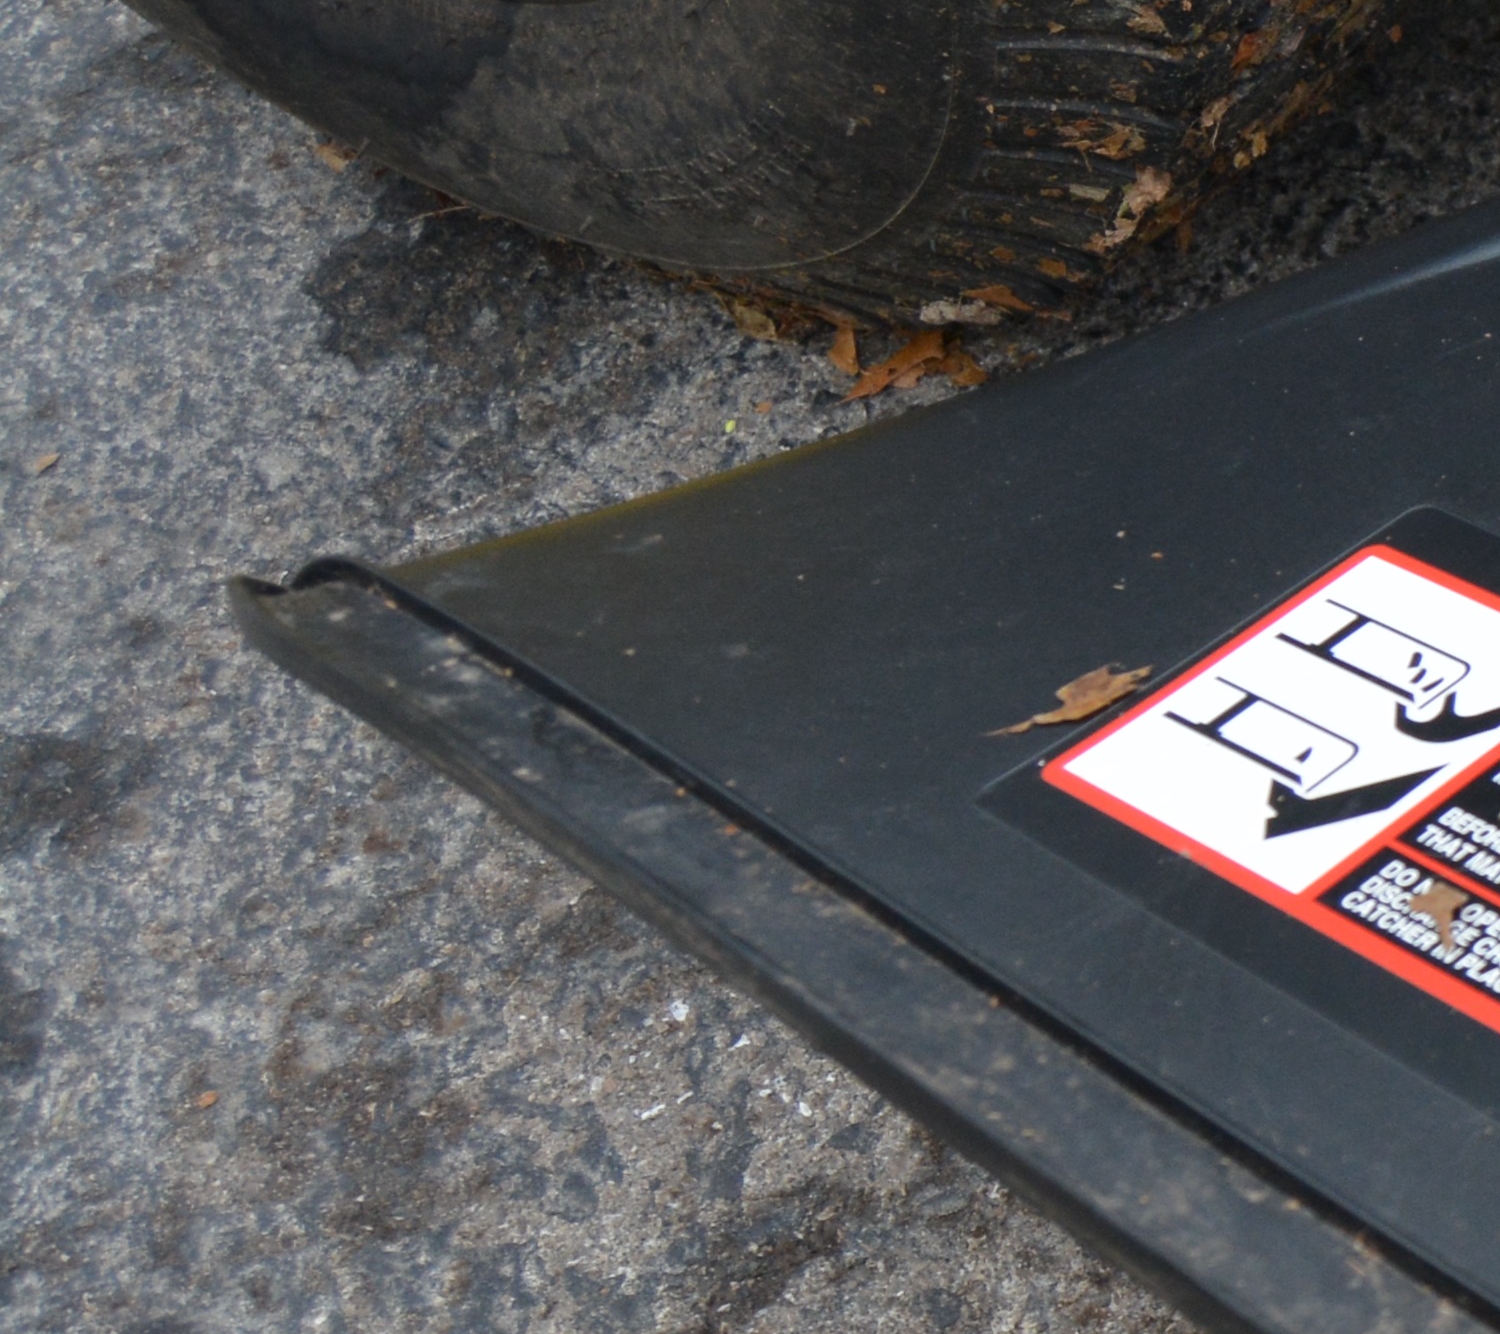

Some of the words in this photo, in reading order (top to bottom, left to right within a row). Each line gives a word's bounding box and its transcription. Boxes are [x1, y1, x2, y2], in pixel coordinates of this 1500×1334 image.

[1416, 823, 1476, 861] THAT
[1378, 859, 1419, 887] DO
[1340, 890, 1440, 952] CATCHER
